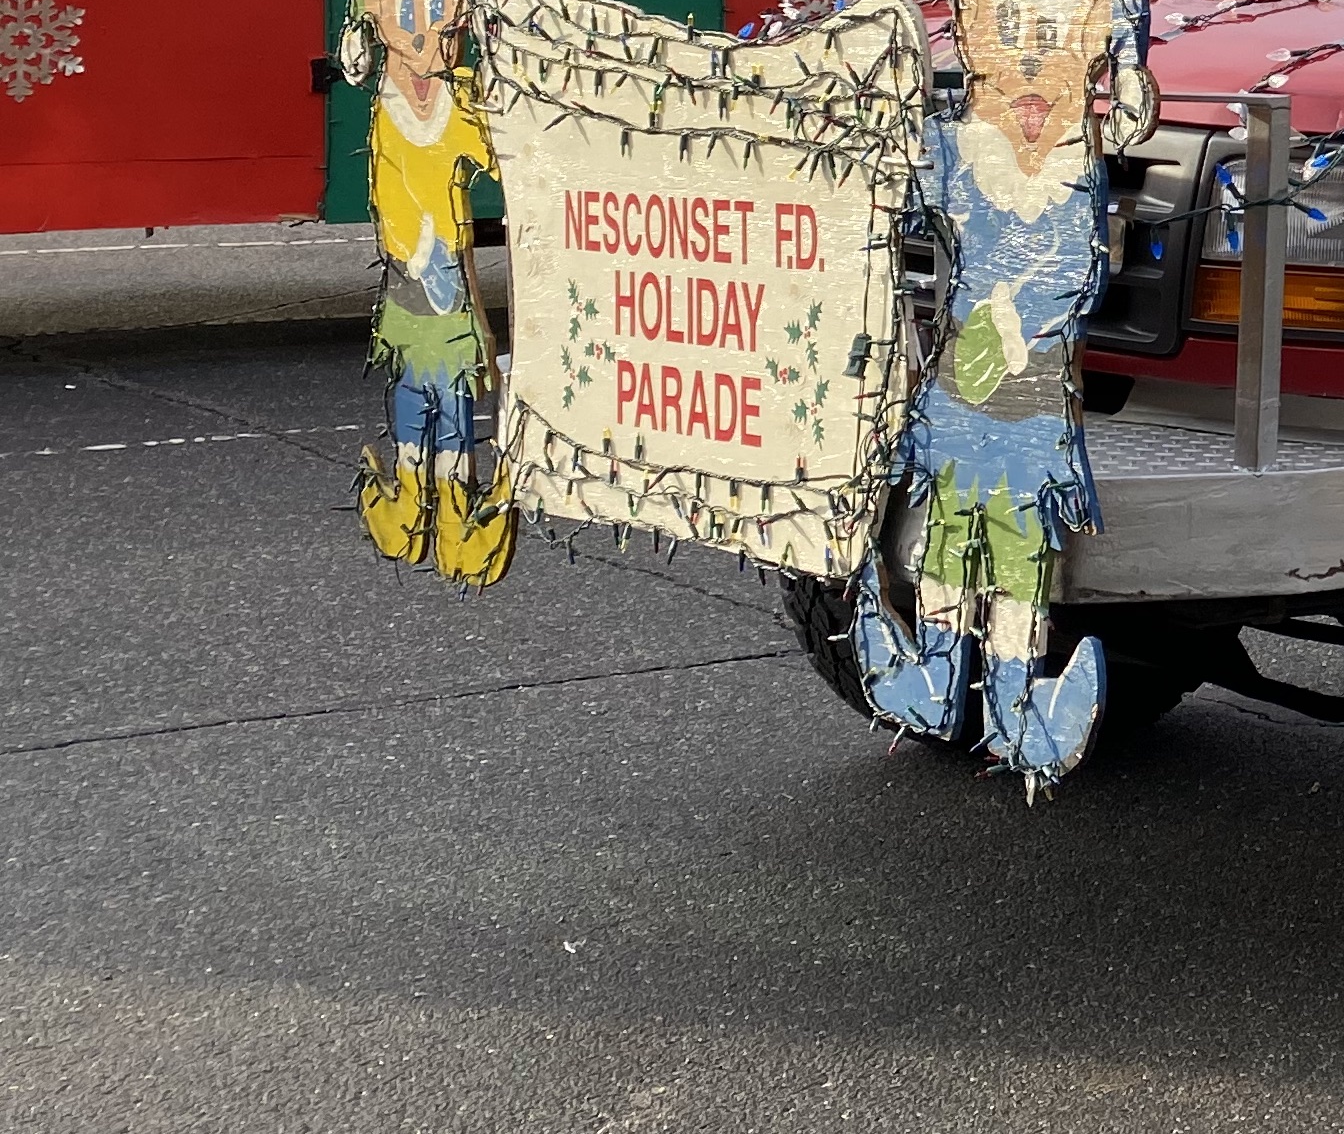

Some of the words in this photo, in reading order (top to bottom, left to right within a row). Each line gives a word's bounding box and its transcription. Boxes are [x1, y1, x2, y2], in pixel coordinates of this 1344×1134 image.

[564, 189, 755, 265] NESCONSET
[614, 269, 765, 353] HOLIDAY
[616, 359, 762, 448] PARADE
